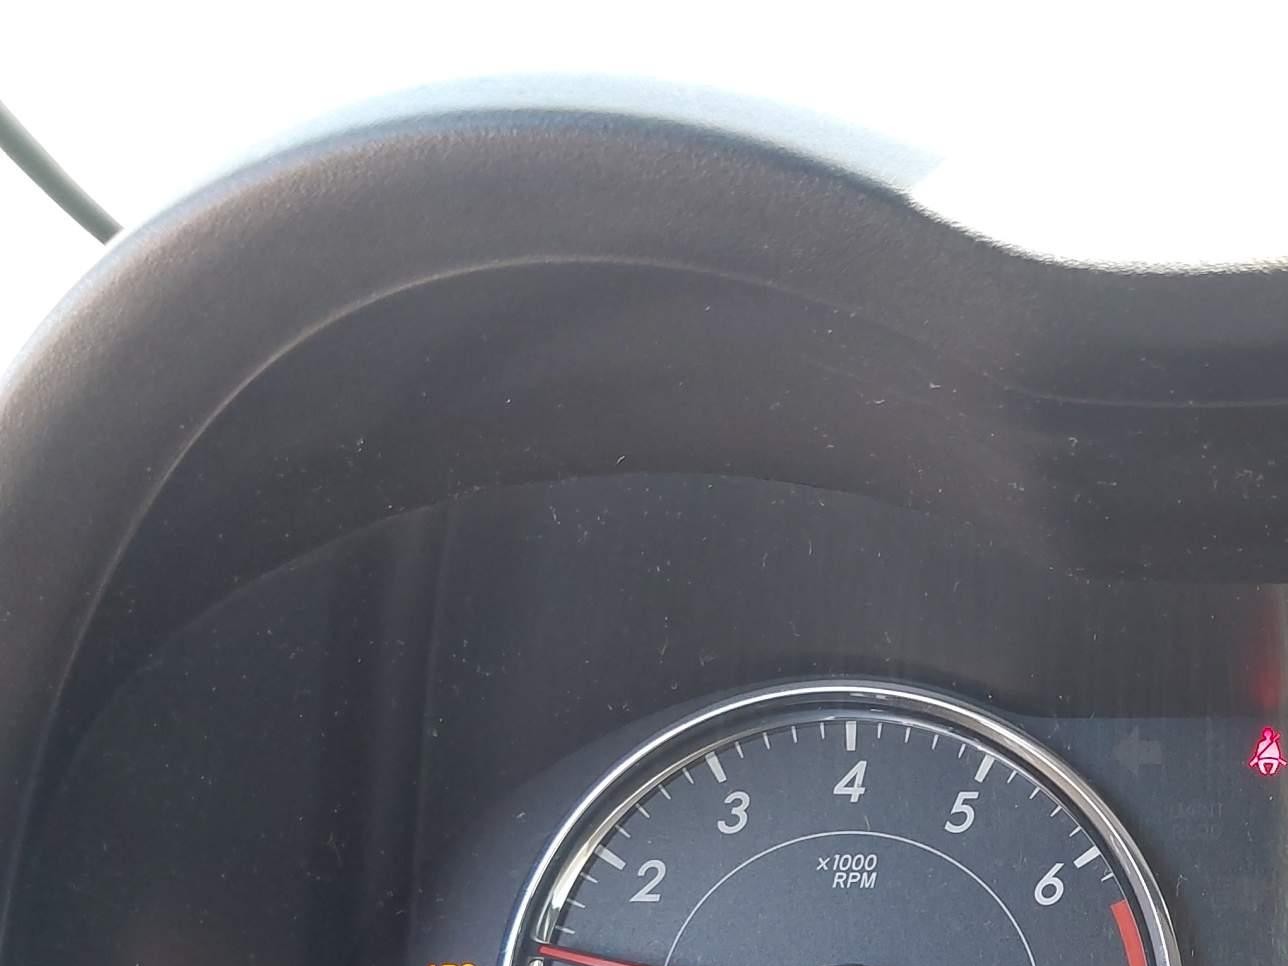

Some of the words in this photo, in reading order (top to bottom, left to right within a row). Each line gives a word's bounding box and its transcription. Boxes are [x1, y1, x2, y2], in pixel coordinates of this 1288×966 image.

[833, 761, 869, 802] 4
[717, 792, 751, 833] 3
[945, 792, 979, 833] 5
[630, 860, 667, 902] 2
[832, 871, 877, 888] RPM
[1034, 864, 1065, 905] 6
